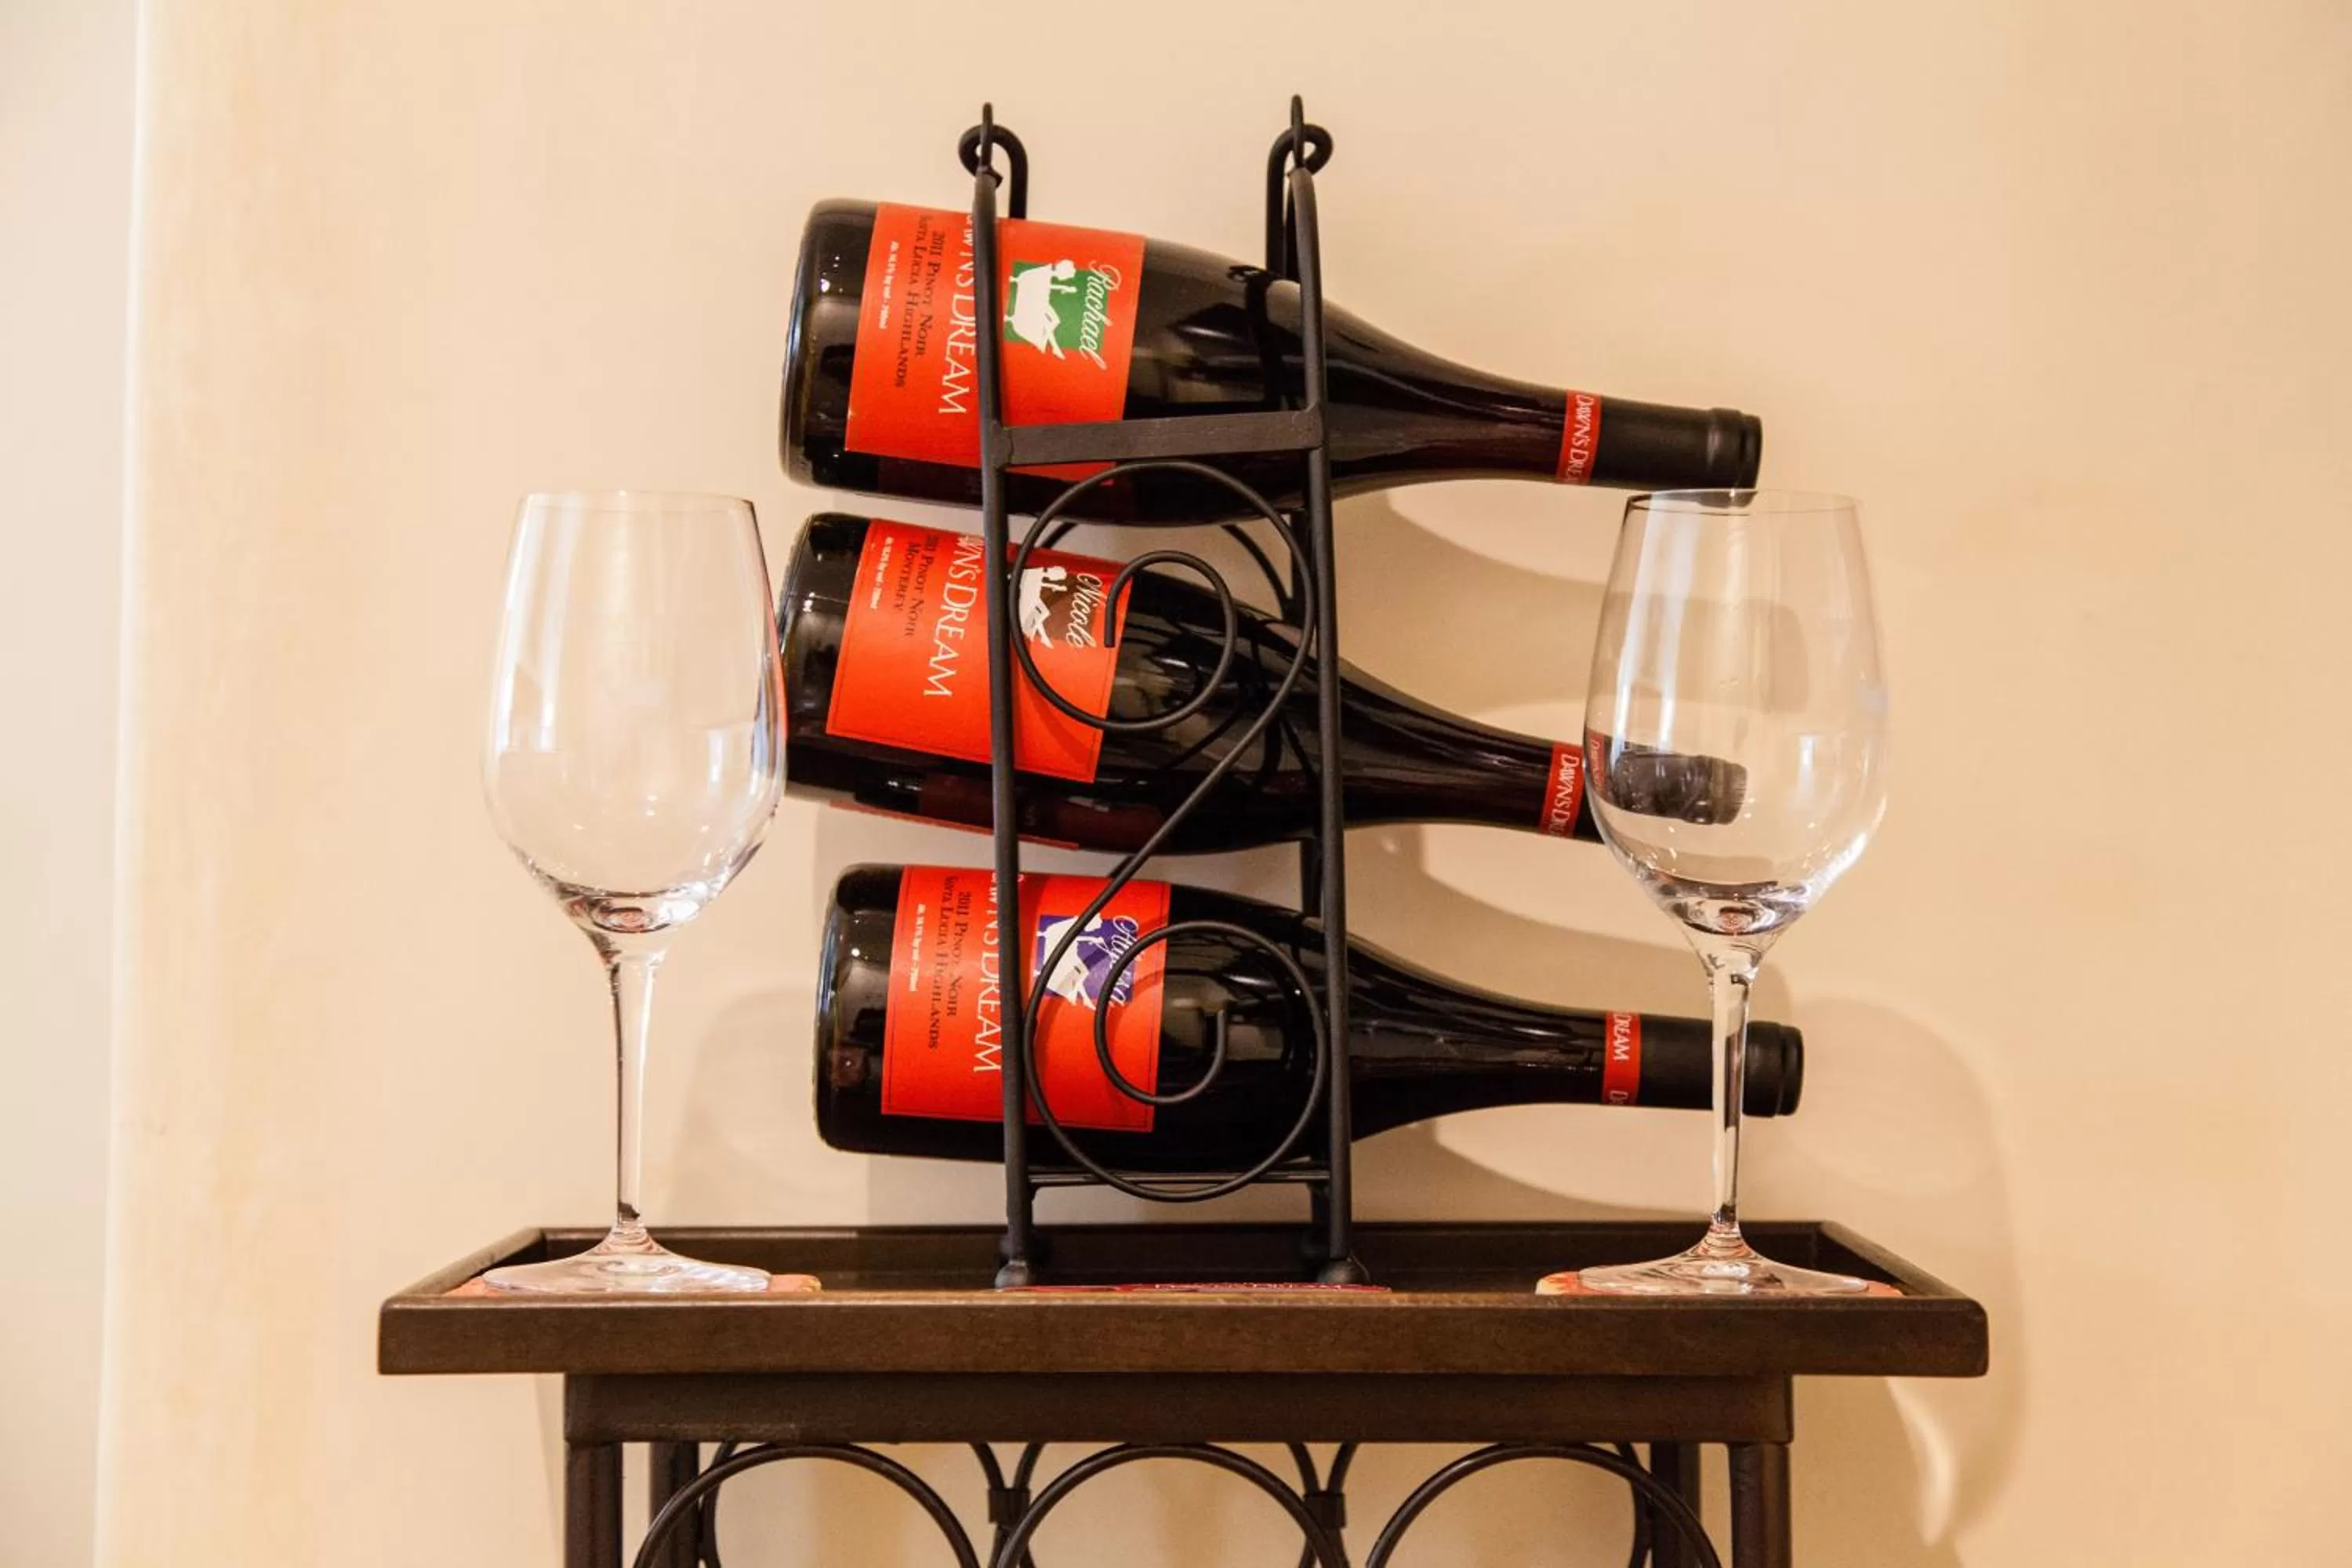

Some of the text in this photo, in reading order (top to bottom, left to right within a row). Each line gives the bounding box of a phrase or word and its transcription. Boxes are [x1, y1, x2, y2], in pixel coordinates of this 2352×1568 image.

[938, 293, 977, 414] DREAM
[1078, 259, 1123, 371] Rachael
[922, 582, 979, 697] DREAM
[1065, 572, 1107, 649] Nicole
[955, 891, 973, 916] 2011
[972, 951, 1002, 1073] DREAM
